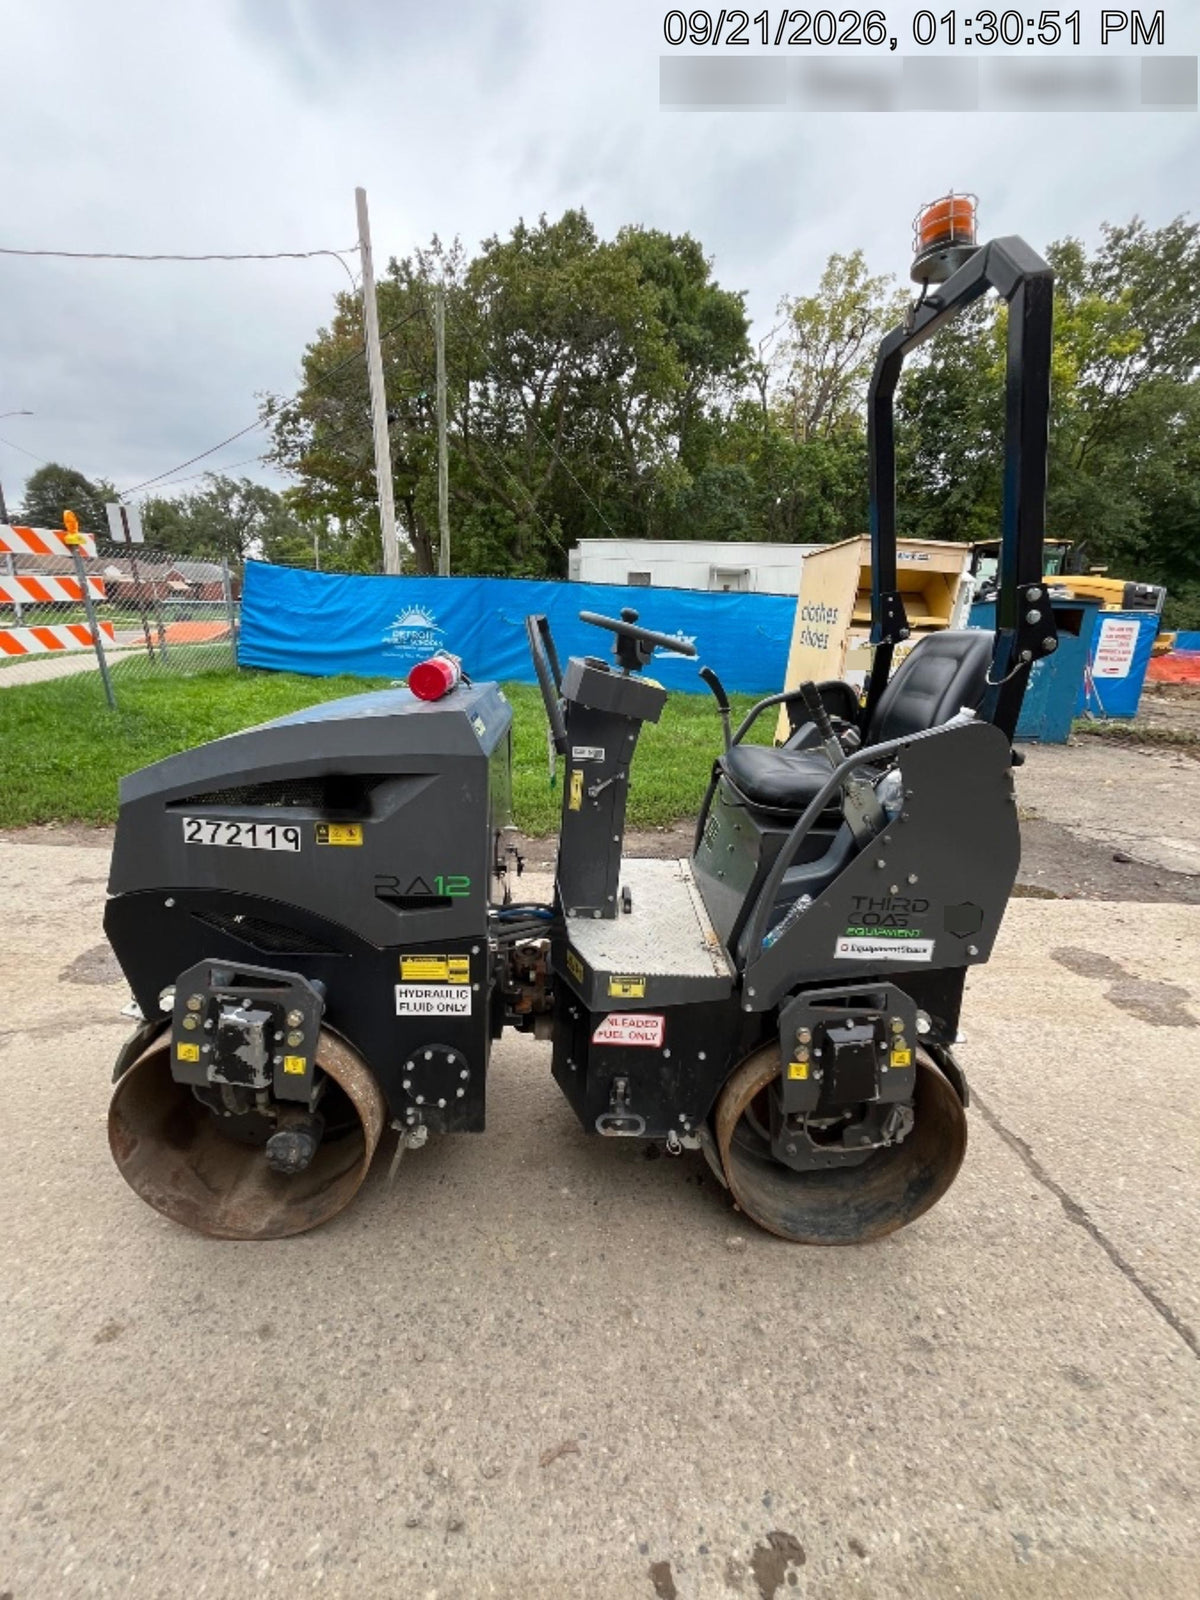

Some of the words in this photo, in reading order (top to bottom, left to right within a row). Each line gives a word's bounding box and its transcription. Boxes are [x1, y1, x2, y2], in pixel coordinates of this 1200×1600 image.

[801, 600, 838, 624] clothes
[800, 626, 829, 649] shoes
[186, 820, 299, 850] 272119
[374, 875, 471, 896] RA12
[852, 896, 930, 913] THIRD
[845, 927, 922, 938] EQUIPMENT
[399, 989, 469, 1000] HYDRAULIC
[399, 1002, 434, 1012] FLUID
[436, 1003, 467, 1012] ONLY
[607, 1018, 658, 1028] NLEADED
[629, 1031, 657, 1041] ONLY
